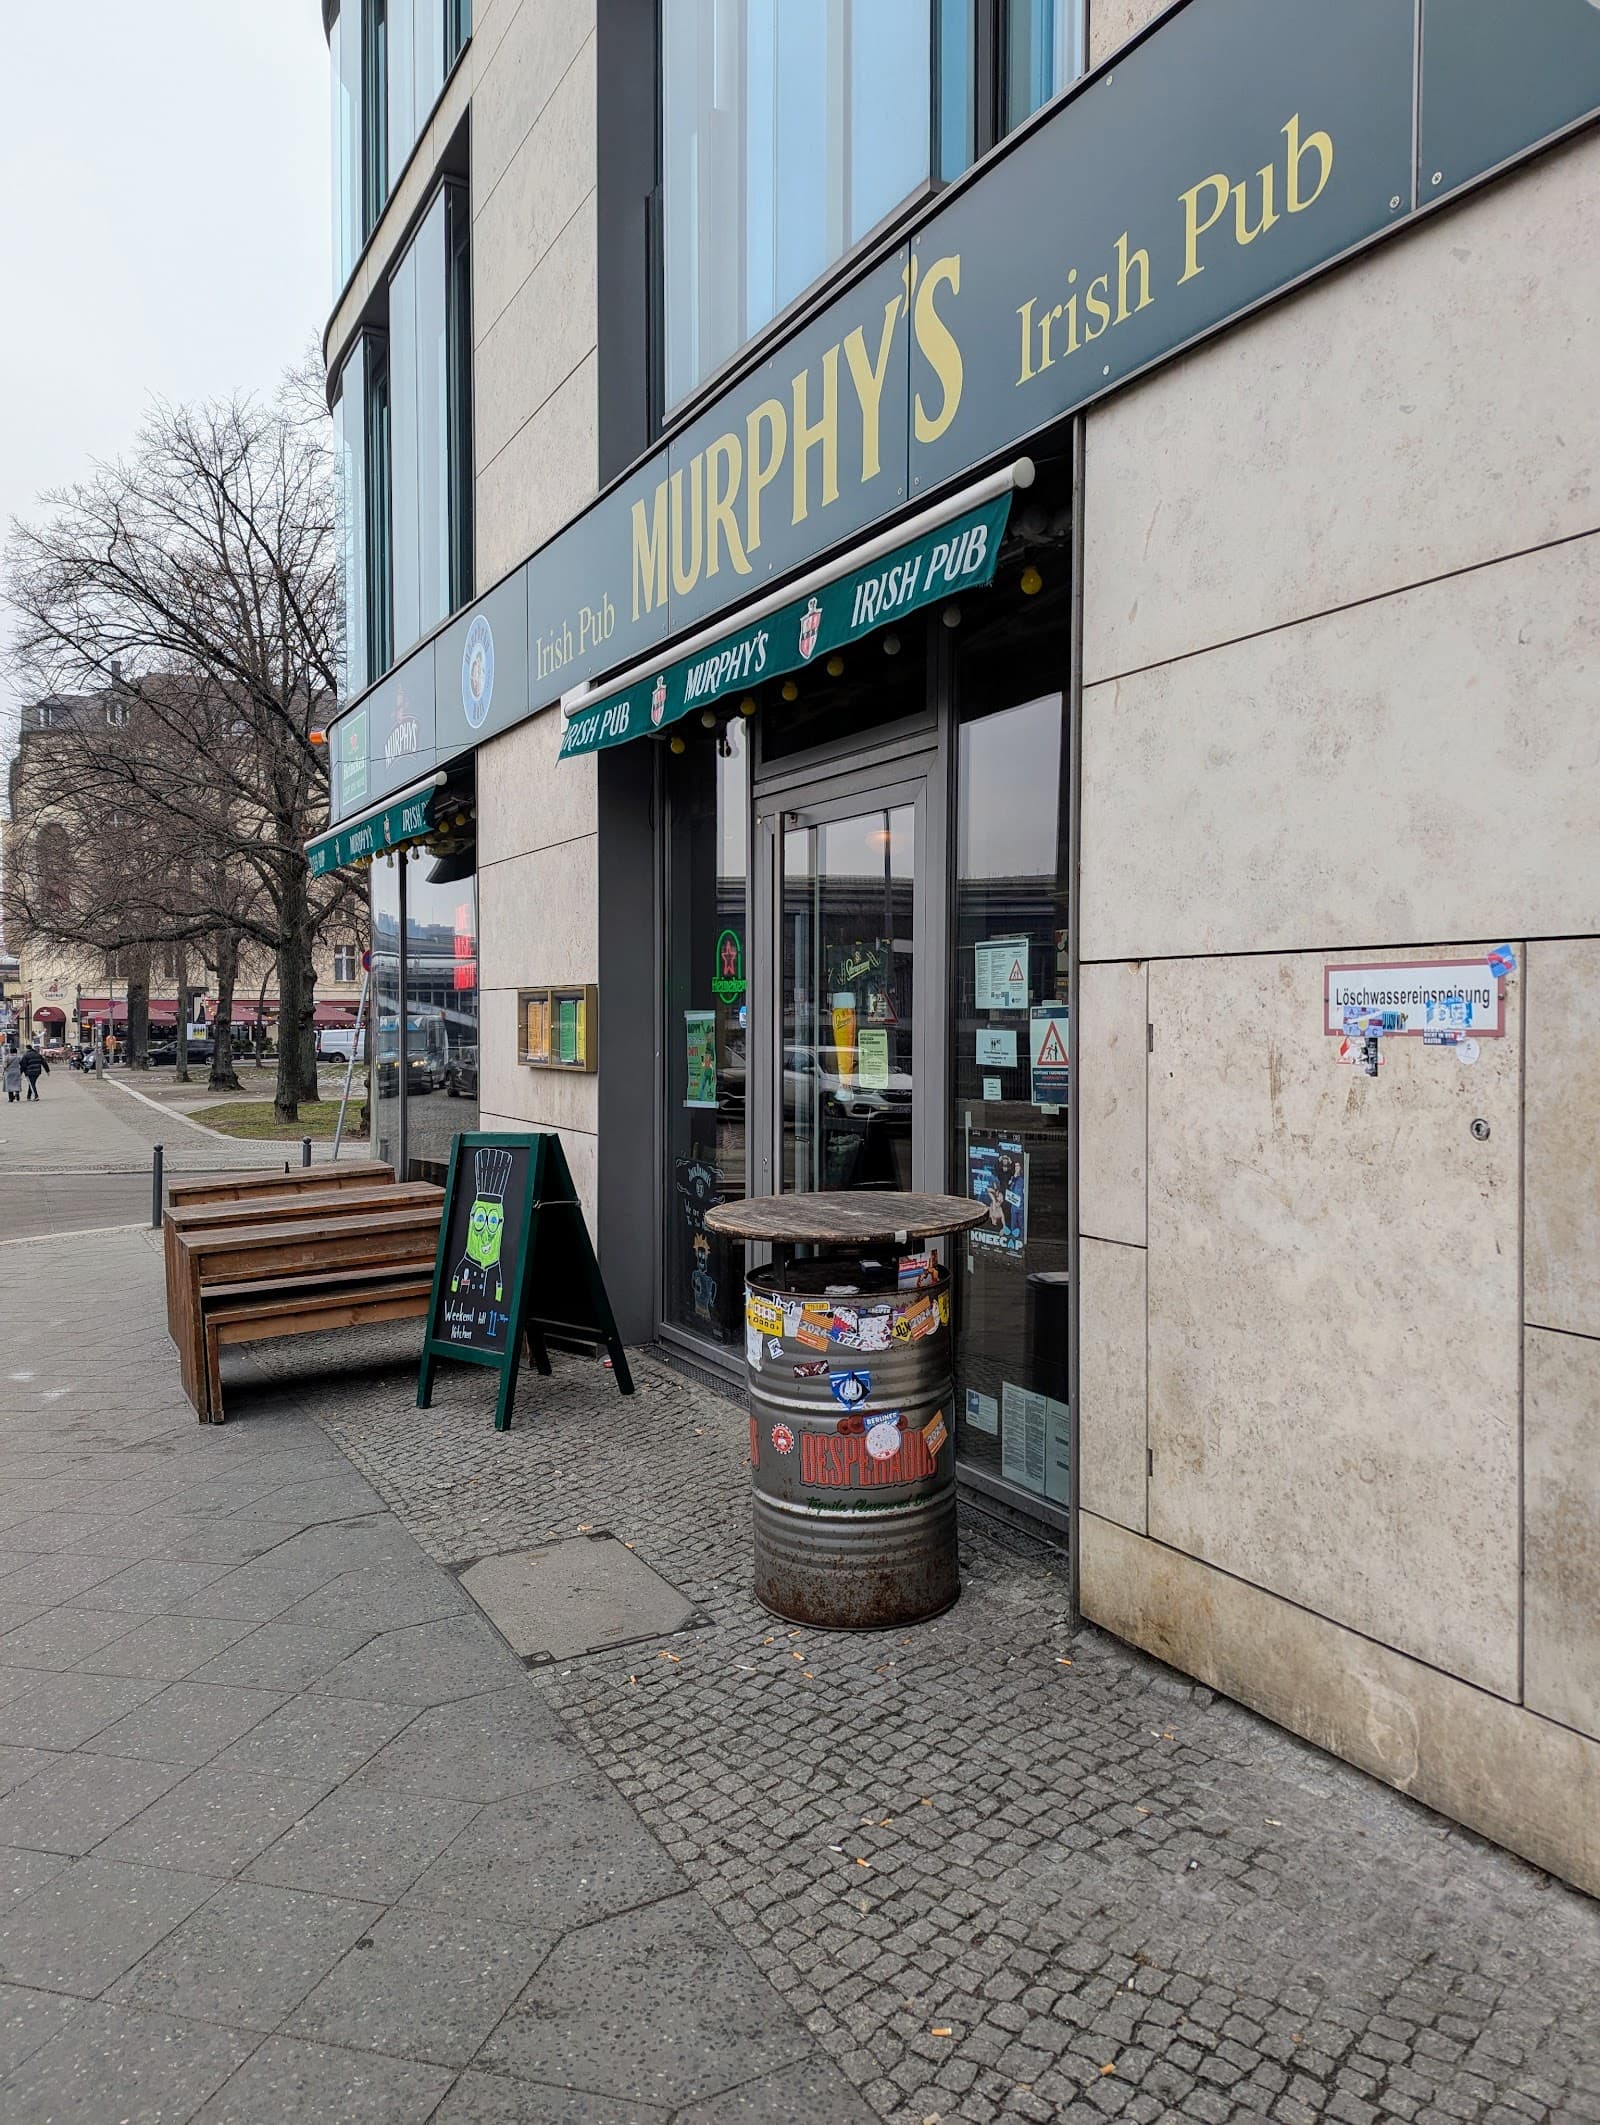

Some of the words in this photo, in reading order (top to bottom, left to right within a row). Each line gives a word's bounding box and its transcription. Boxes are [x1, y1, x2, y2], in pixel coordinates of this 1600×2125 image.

[1015, 231, 1155, 387] Irish
[1176, 113, 1334, 286] Pub
[631, 253, 963, 622] MURPHY'S
[851, 556, 922, 627] IRISH
[926, 525, 987, 590] PUB
[536, 617, 574, 681] Irish
[578, 592, 615, 656] Pub
[684, 629, 768, 703] MURPHY'S
[599, 702, 630, 740] PUB
[1336, 984, 1491, 1009] Löschwassereinspeisung
[970, 1230, 1024, 1251] KNEECAP
[444, 1299, 475, 1323] Weekend
